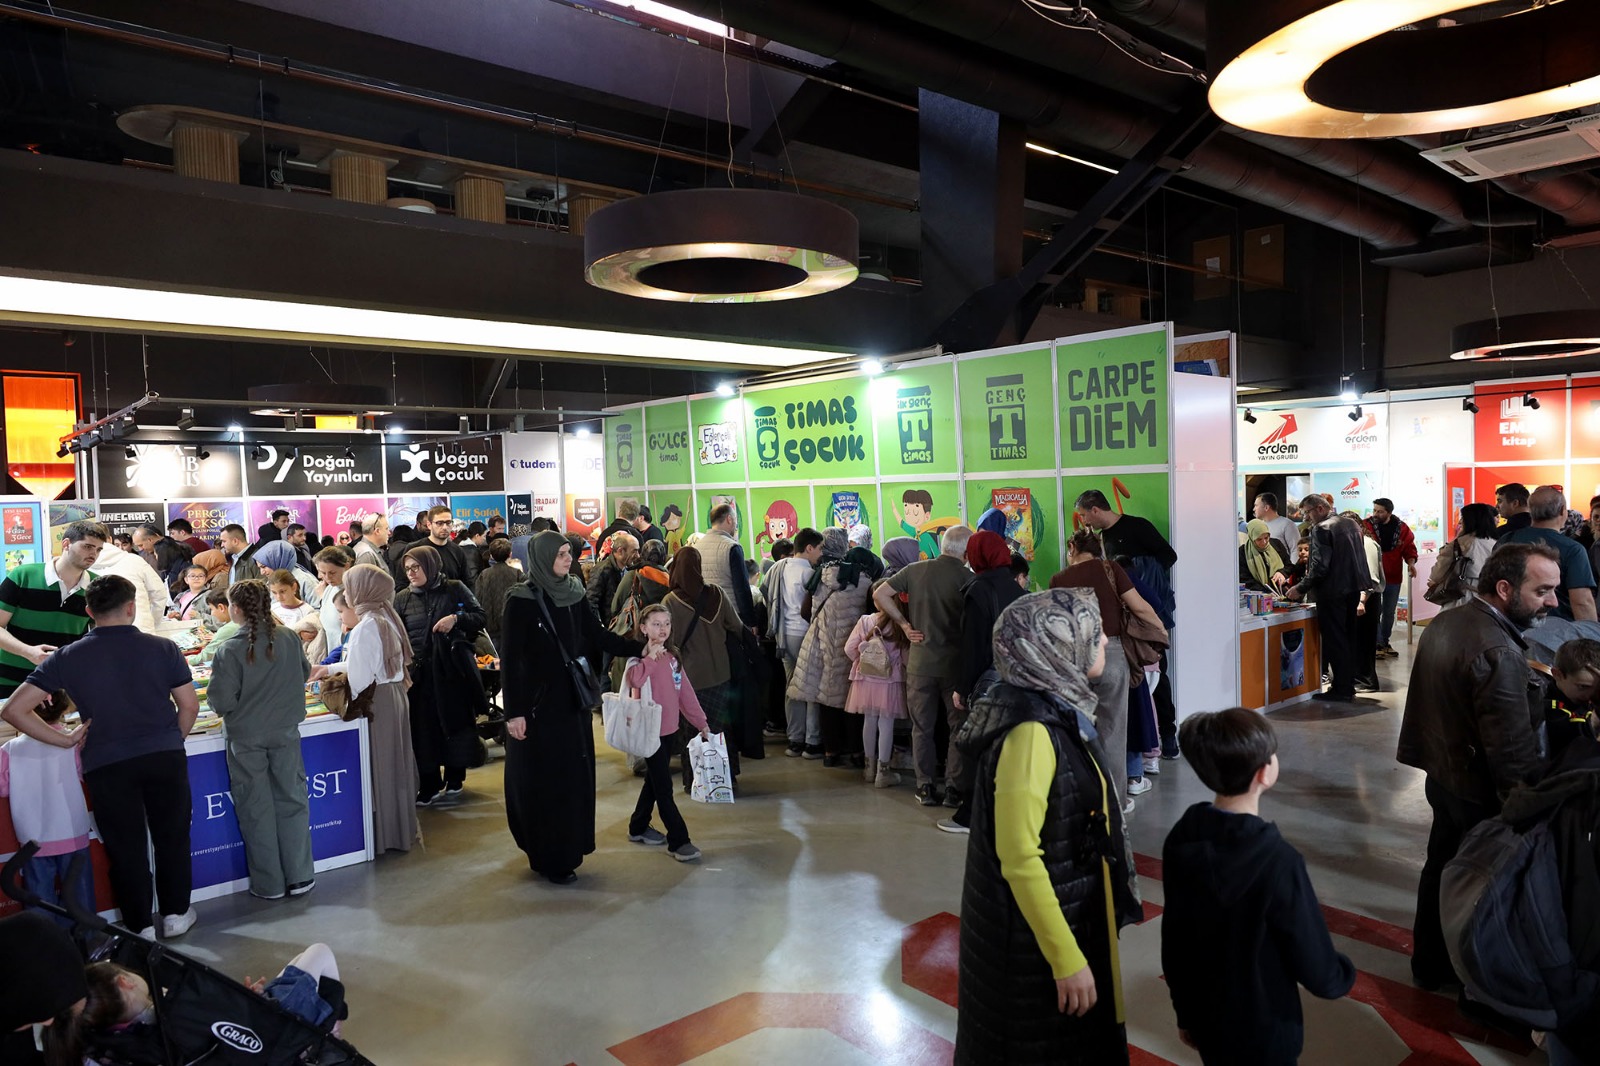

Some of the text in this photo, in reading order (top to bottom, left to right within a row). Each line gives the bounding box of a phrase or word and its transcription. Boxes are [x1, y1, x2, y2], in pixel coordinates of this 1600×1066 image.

[1067, 360, 1156, 402] CARPE
[908, 397, 932, 409] genç
[985, 386, 1026, 405] GENÇ
[648, 430, 688, 450] GÜLCE
[1344, 434, 1378, 444] erdem
[1502, 436, 1537, 447] kitap
[784, 434, 866, 471] ÇOCUK
[1257, 443, 1299, 455] erdem
[302, 454, 355, 471] Doğan
[435, 451, 489, 468] Doğan
[520, 459, 557, 469] tudem
[303, 469, 373, 487] Yayınları
[435, 467, 485, 485] Çocuk
[99, 511, 156, 524] INECRAFT
[187, 508, 229, 519] PERCY
[456, 507, 472, 517] Elif
[219, 1025, 260, 1050] GRACO
